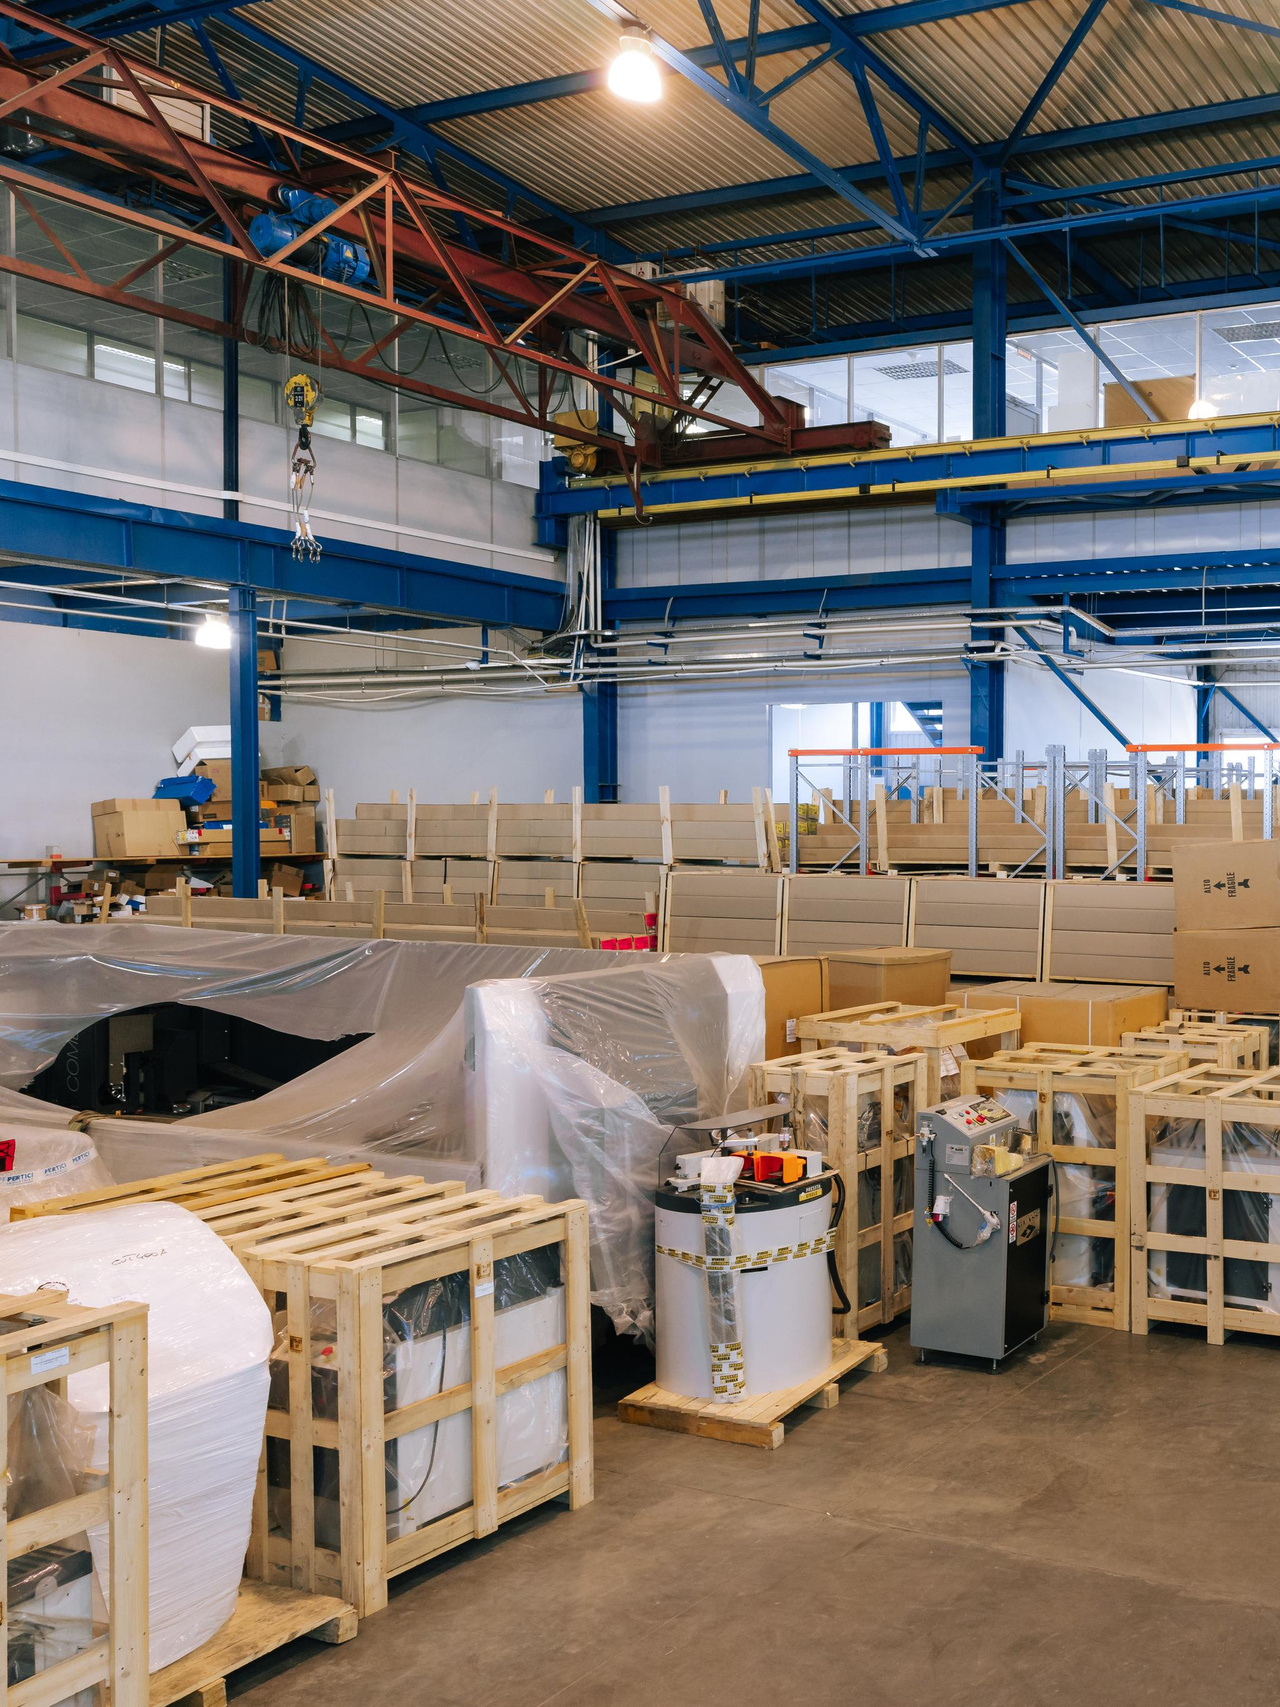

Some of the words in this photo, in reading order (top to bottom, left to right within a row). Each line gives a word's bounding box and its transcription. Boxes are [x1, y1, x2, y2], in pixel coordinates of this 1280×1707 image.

[1203, 879, 1211, 893] ALTO
[1226, 872, 1236, 898] FRAGILE
[1203, 961, 1211, 976] ALTO
[1226, 956, 1236, 982] FRAGILE
[72, 1151, 91, 1164] PERTICI
[44, 1162, 67, 1174] PERTICI
[7, 1172, 34, 1182] PERTICI
